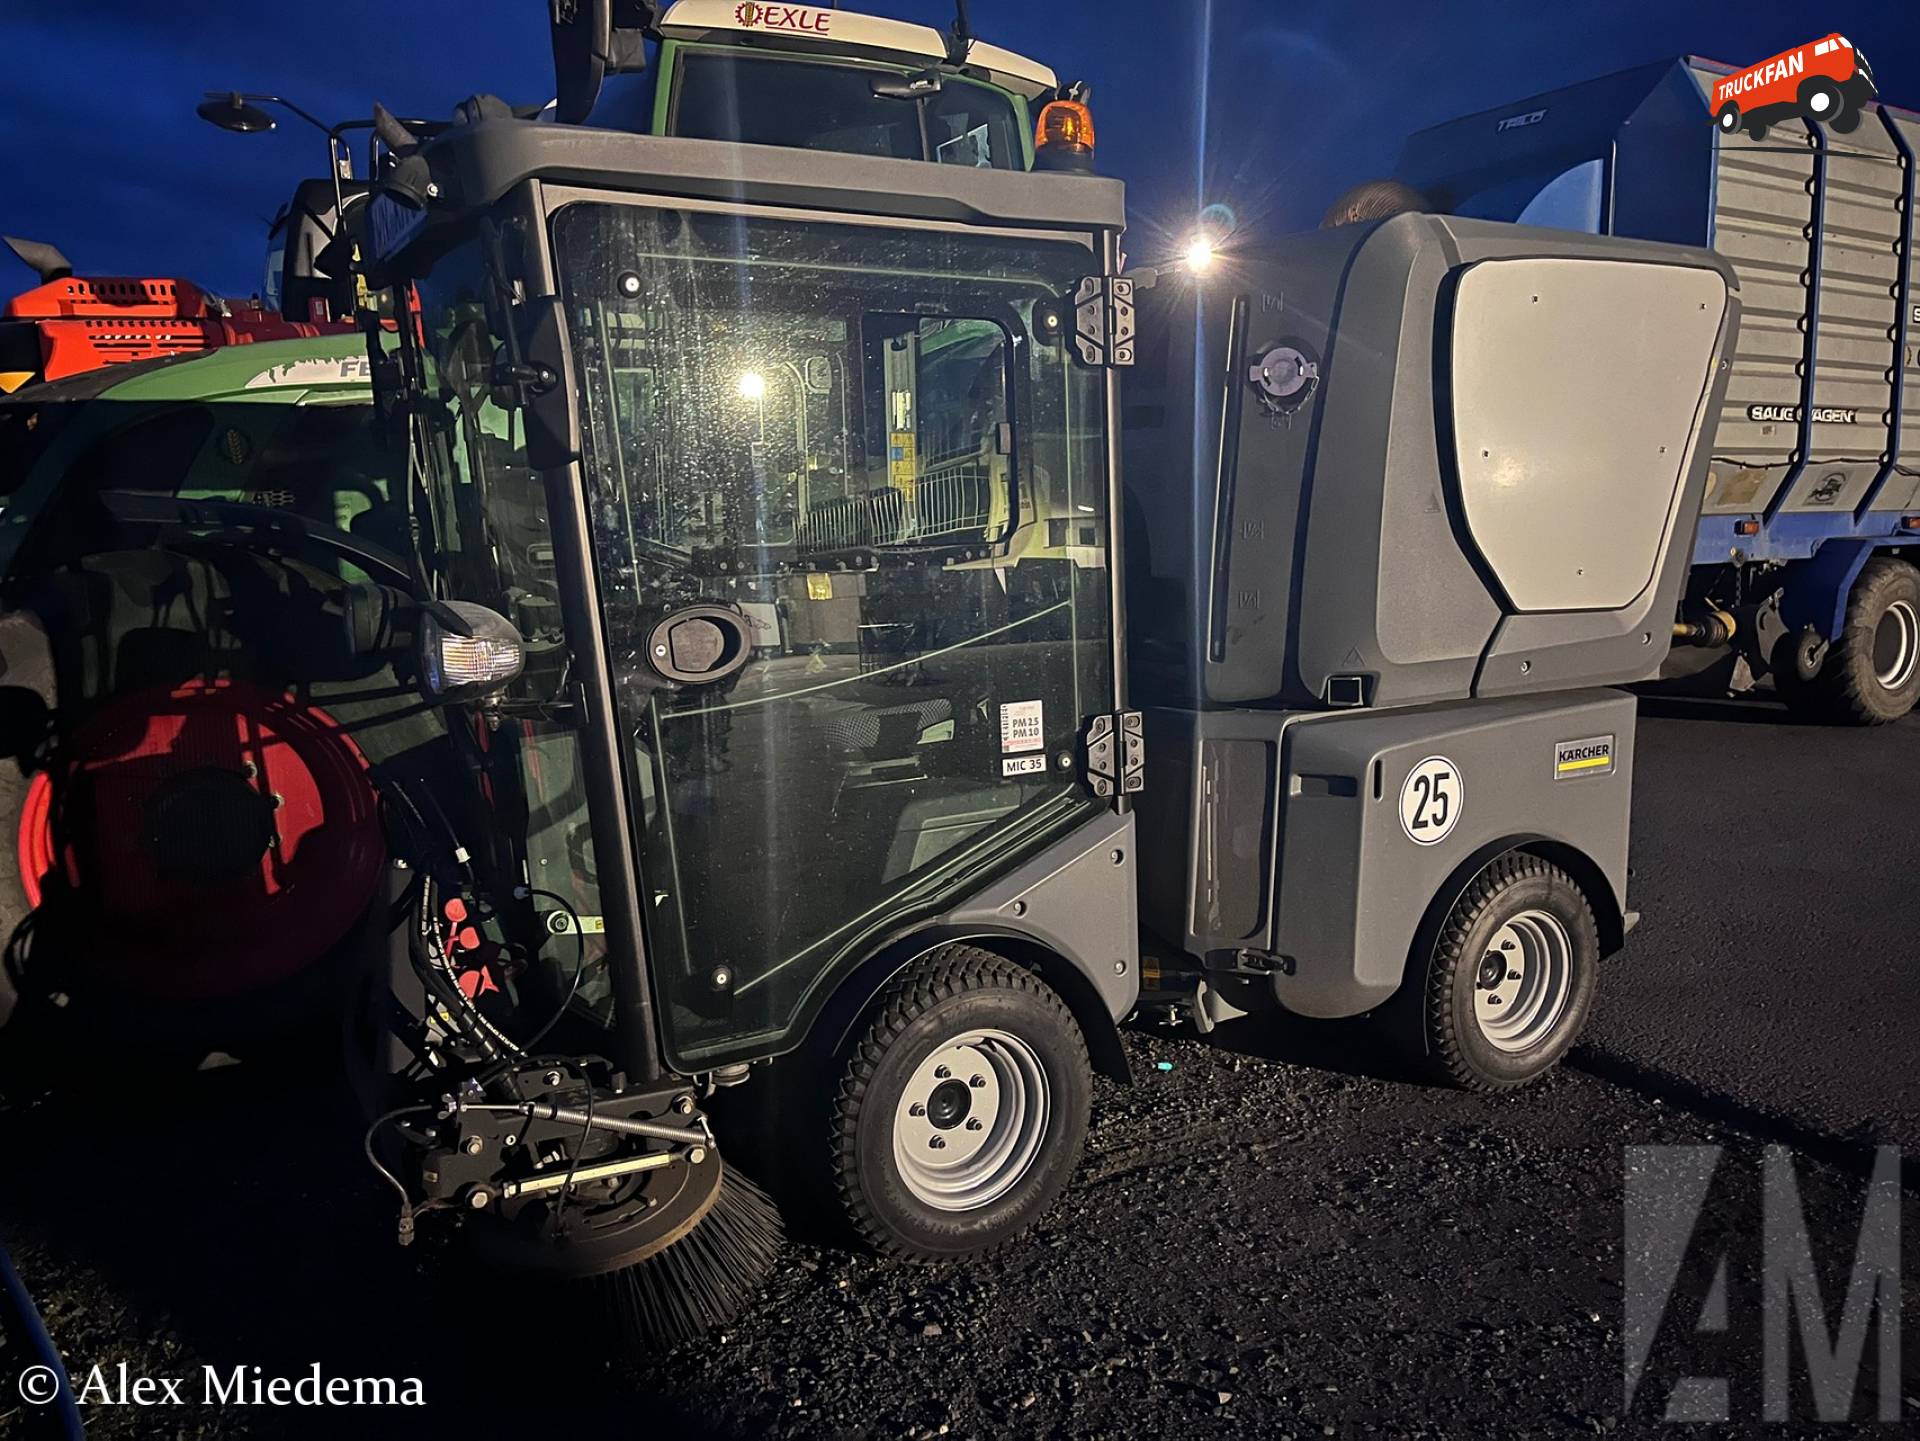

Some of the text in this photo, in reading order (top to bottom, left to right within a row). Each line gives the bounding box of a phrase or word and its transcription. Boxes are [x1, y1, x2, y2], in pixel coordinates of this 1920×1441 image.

[763, 6, 831, 31] EXLE
[1012, 718, 1027, 728] PM
[1012, 727, 1039, 738] PM 10
[1006, 758, 1042, 772] MIC 35
[1411, 772, 1450, 829] 25
